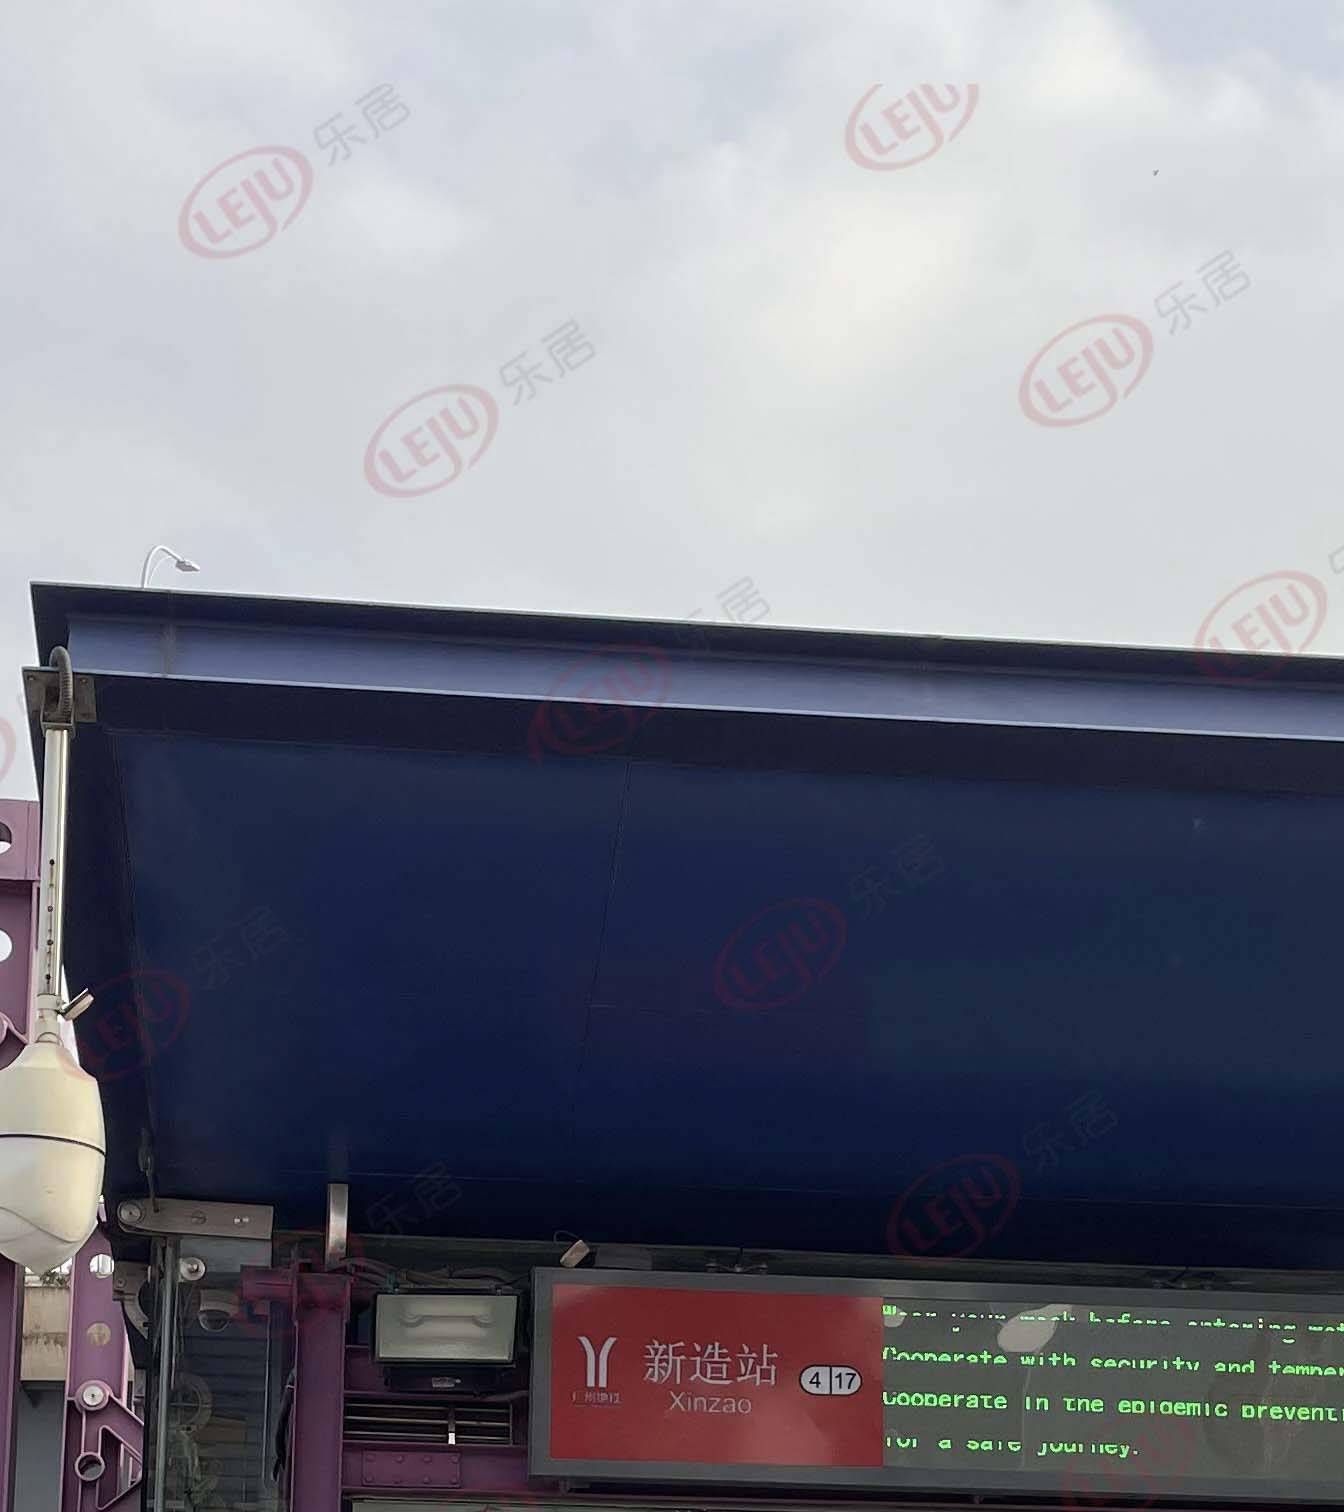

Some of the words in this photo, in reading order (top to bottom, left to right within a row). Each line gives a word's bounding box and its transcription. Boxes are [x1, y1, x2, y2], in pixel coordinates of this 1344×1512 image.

[643, 1339, 779, 1387] 新造站
[808, 1372, 821, 1388] 4
[834, 1373, 857, 1389] 17
[669, 1391, 752, 1414] Xinzao
